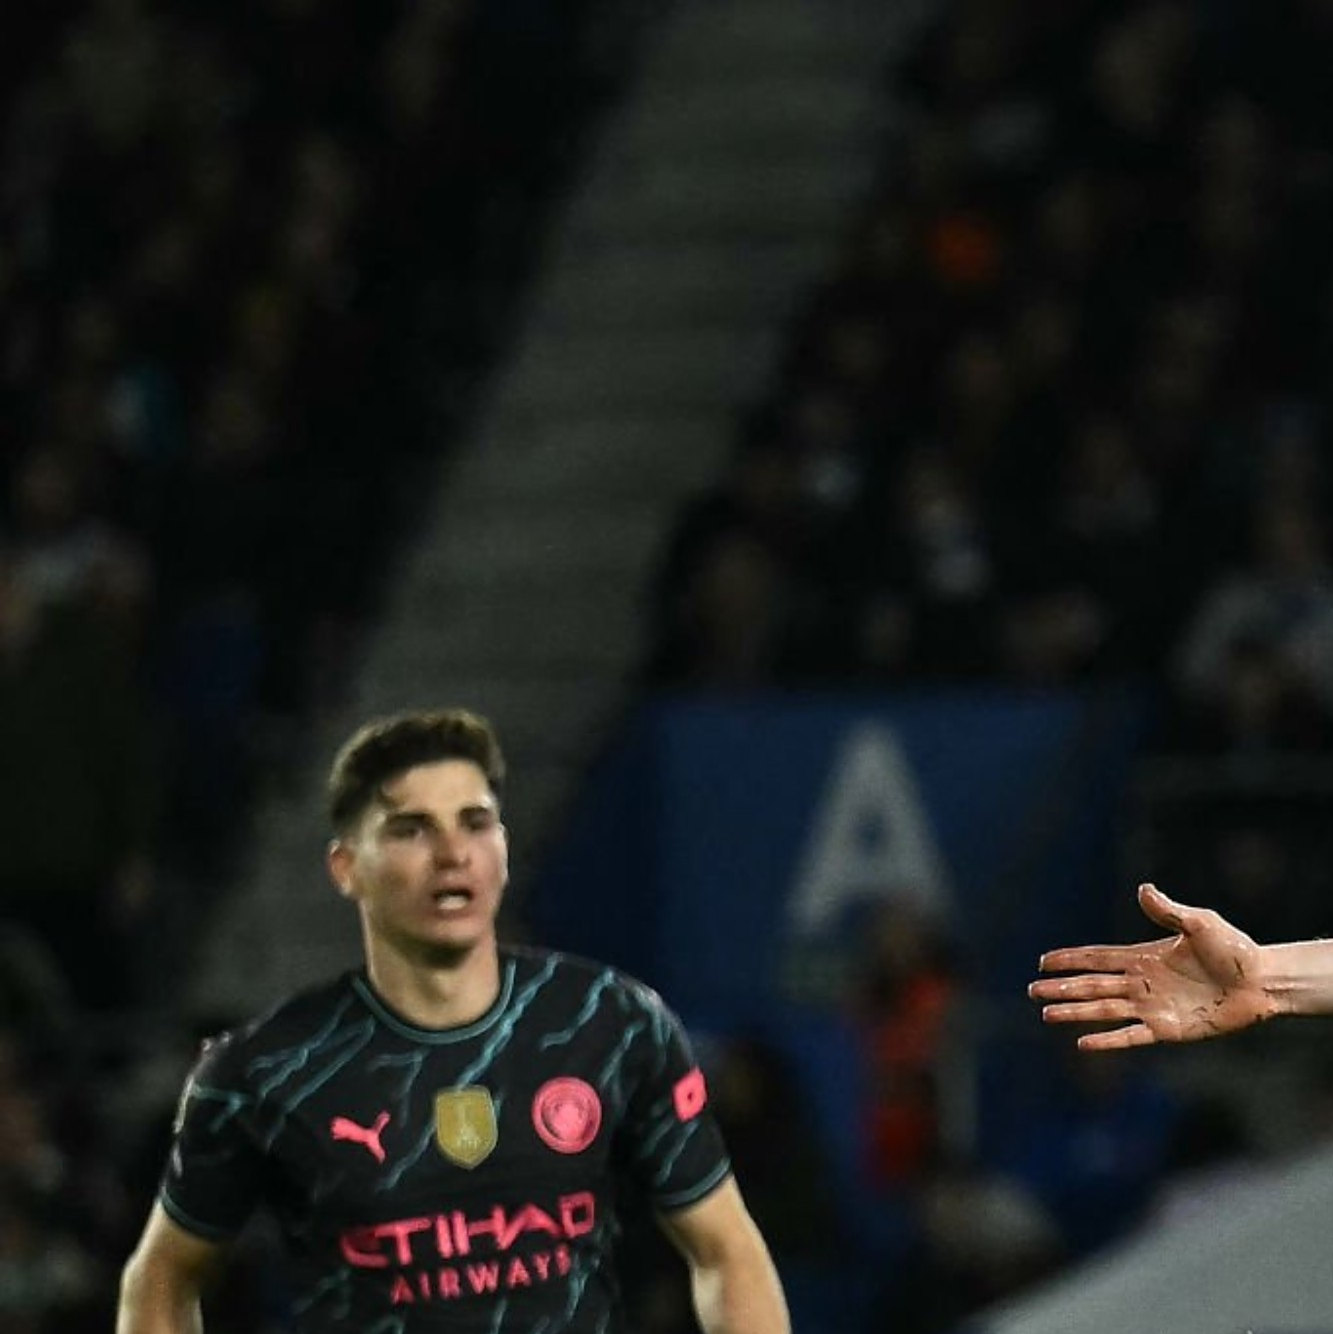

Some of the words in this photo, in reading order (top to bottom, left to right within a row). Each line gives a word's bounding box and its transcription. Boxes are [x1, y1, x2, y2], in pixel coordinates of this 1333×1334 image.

[787, 720, 955, 932] A
[341, 1192, 595, 1267] ETIHAD
[390, 1246, 571, 1304] AIRWAYS
